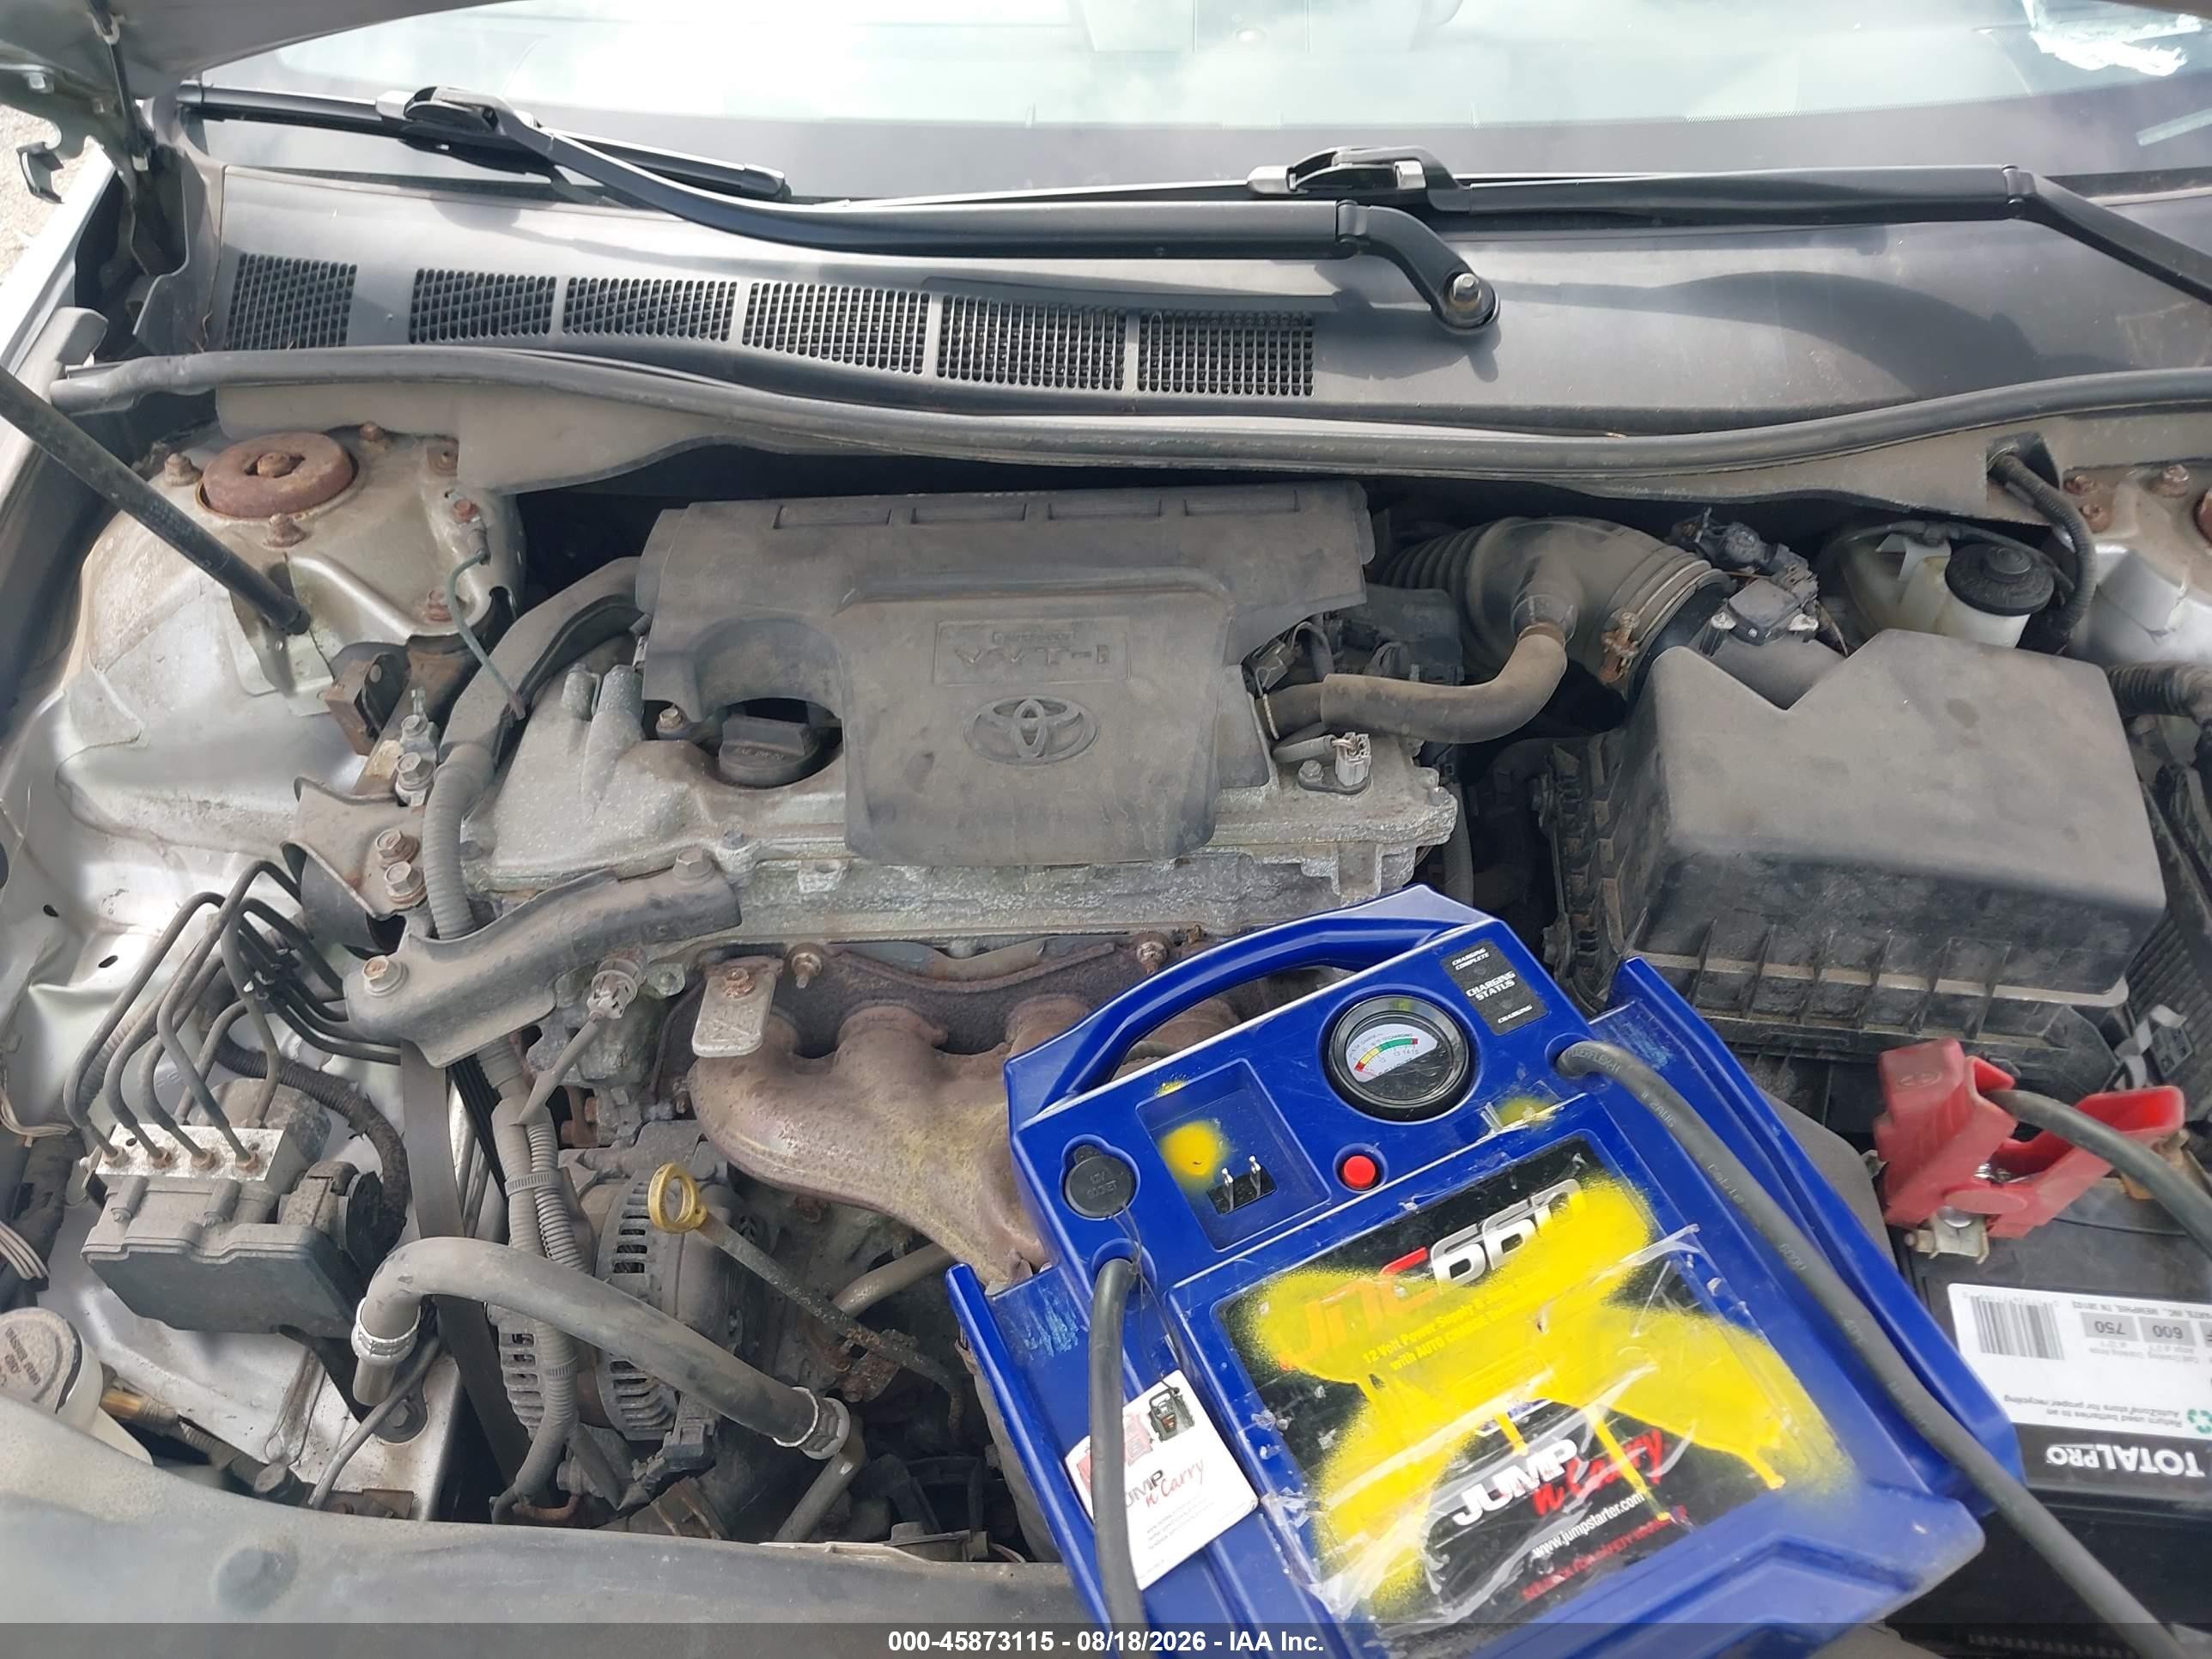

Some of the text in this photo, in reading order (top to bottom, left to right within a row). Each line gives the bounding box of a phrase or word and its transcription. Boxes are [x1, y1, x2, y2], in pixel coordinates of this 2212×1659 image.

[1452, 948, 1486, 965] CHARGING
[1455, 952, 1490, 970] COMPLETE
[1465, 970, 1516, 997] CHARGING
[1476, 980, 1516, 1000] STATUS
[1498, 1006, 1533, 1024] CHARGING
[1362, 1348, 1380, 1364] 12
[1376, 1337, 1403, 1358] Volt
[1399, 1320, 1437, 1346] Power
[1435, 1302, 1476, 1331] Supply
[2093, 1320, 2126, 1335] 750
[2151, 1324, 2184, 1340] 600
[1388, 1313, 1490, 1371] with AUTO CHARGE
[2002, 1394, 2049, 1407] recycling
[2051, 1397, 2083, 1410] proper
[2086, 1402, 2100, 1412] for
[2102, 1404, 2128, 1413] store
[2075, 1410, 2118, 1422] batteries
[2120, 1414, 2144, 1424] used
[2147, 1416, 2182, 1428] Return
[2046, 1443, 2206, 1478] TOTALPRO
[1162, 1458, 1205, 1498] Carry
[1452, 1438, 1577, 1526] JUMP
[1124, 1469, 1164, 1506] UMP
[1532, 1492, 1645, 1559] www.jumpstarter.com
